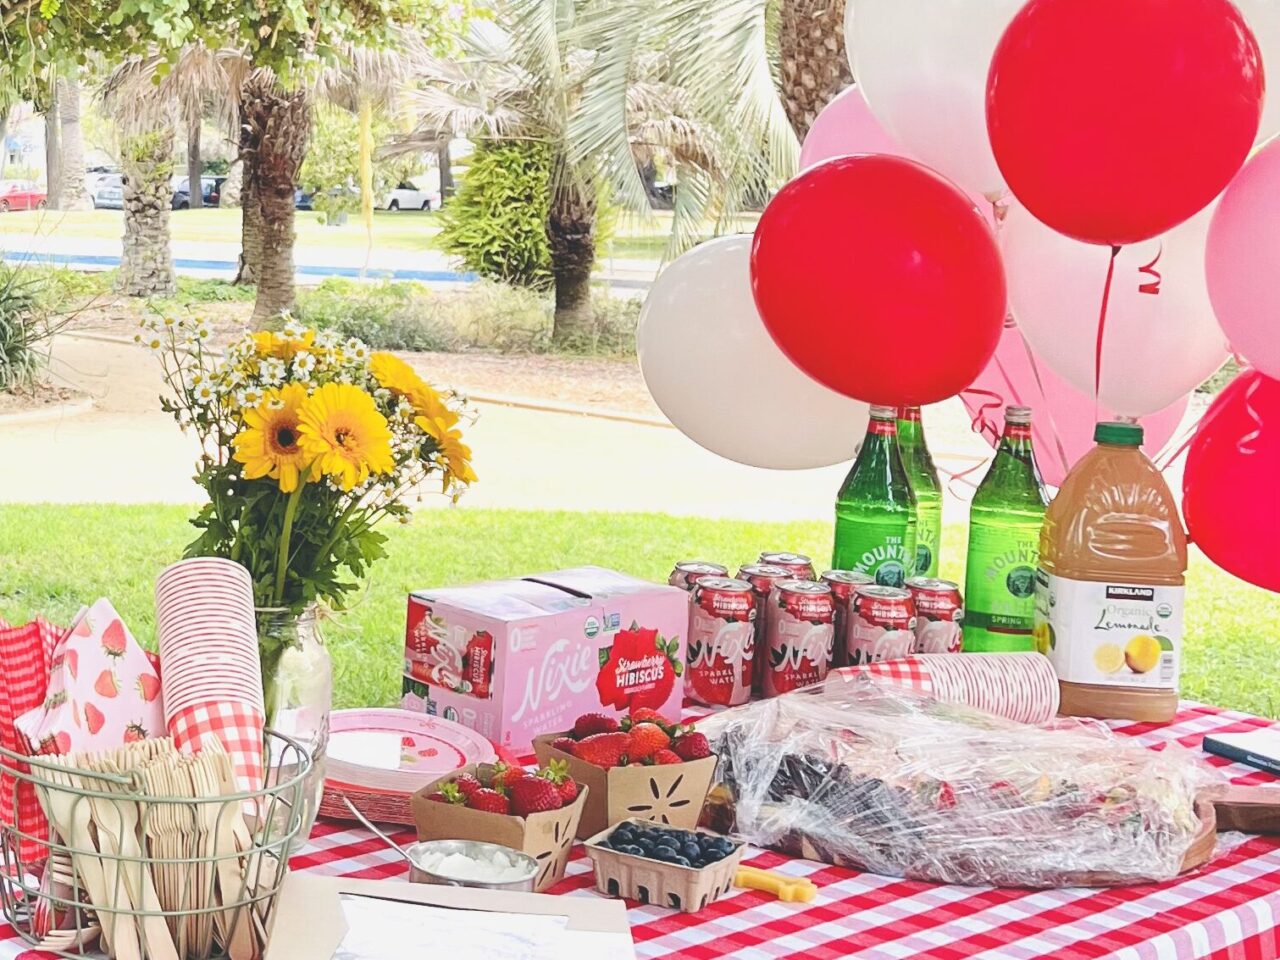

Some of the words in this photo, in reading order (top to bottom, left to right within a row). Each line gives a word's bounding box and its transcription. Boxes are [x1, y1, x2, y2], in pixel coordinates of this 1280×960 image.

[885, 536, 902, 544] THE
[1107, 587, 1153, 596] KIRKLAND
[1106, 604, 1151, 618] Organic
[991, 615, 1022, 625] SPRING
[1094, 608, 1162, 634] Lemonade
[615, 654, 665, 675] Strawberry
[511, 639, 592, 722] Nixie
[616, 665, 665, 689] HIBISCUS
